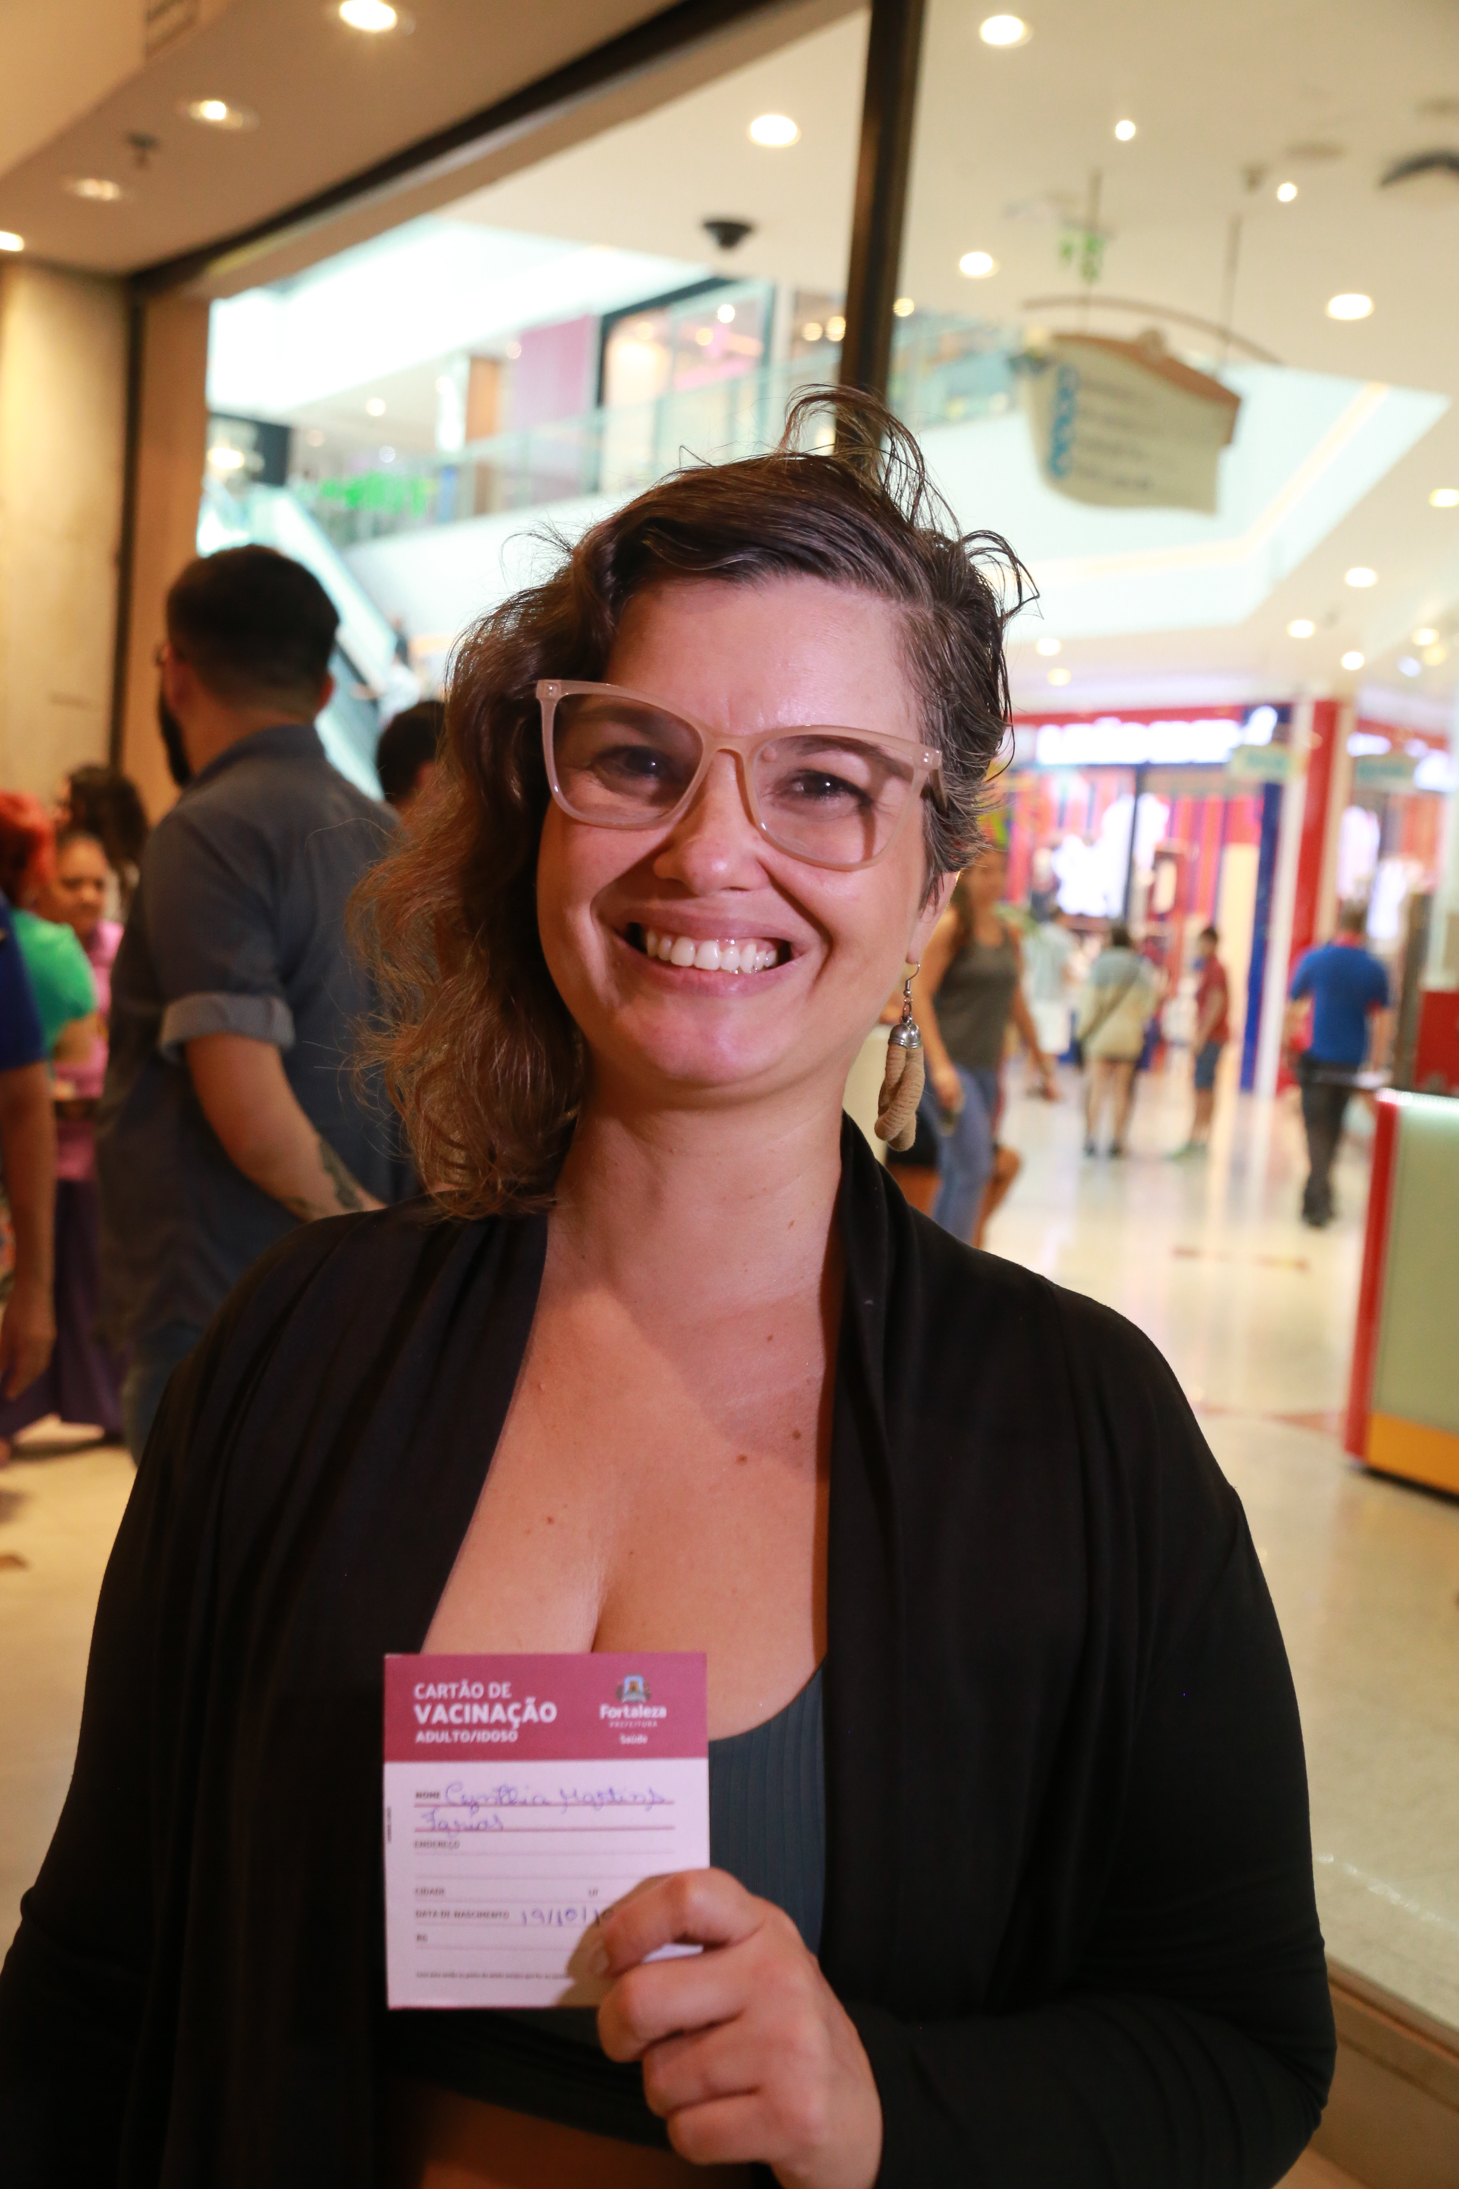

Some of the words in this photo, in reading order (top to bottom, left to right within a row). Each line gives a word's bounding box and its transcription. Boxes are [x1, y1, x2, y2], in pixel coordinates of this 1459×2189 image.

[414, 1679, 485, 1699] CARTÃO
[488, 1681, 512, 1699] DE
[413, 1696, 558, 1729] VACINAÇÃO
[600, 1703, 667, 1719] Fortaleza
[415, 1729, 518, 1743] ADULTO/IDOSO
